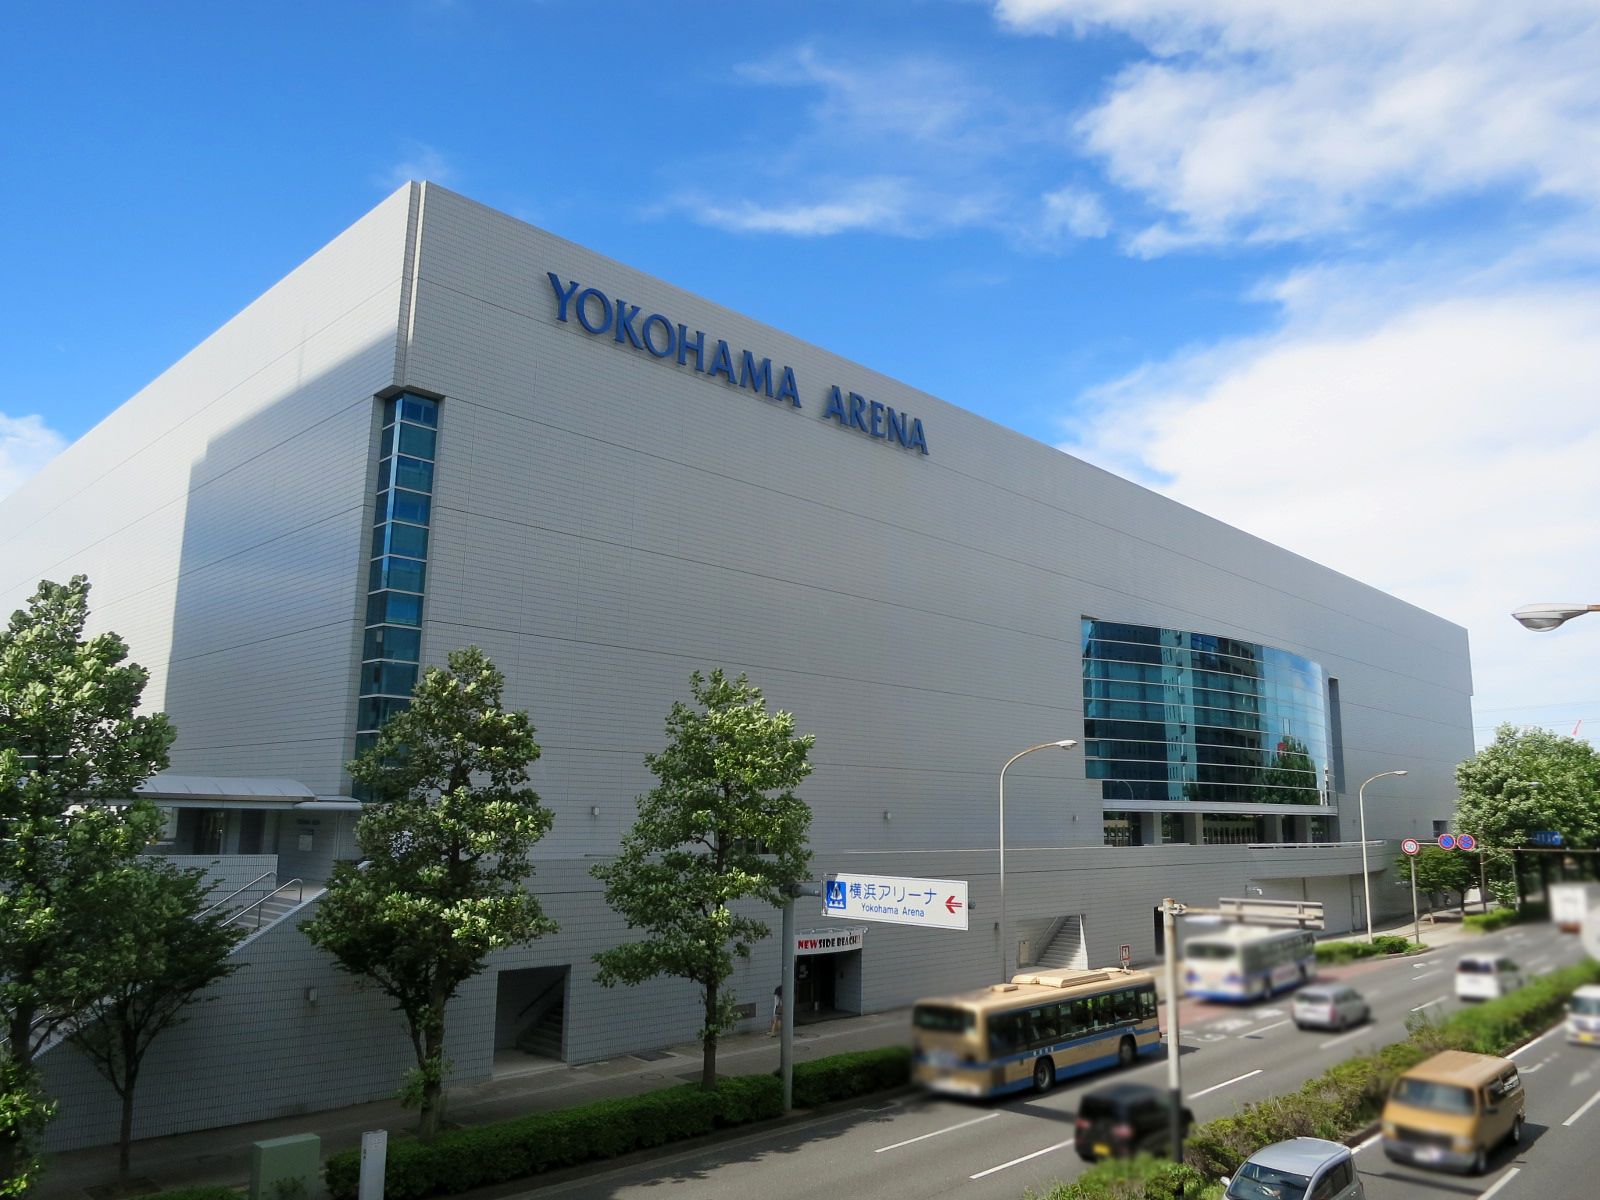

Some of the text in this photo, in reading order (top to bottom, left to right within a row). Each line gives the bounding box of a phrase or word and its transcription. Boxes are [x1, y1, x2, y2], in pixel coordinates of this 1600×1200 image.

[547, 272, 930, 456] YOKOHAMA ARENA
[849, 882, 937, 905] 横浜アリーナ
[861, 902, 925, 918] Yokohama Arena
[798, 939, 818, 950] NEW
[818, 938, 836, 949] SIDE
